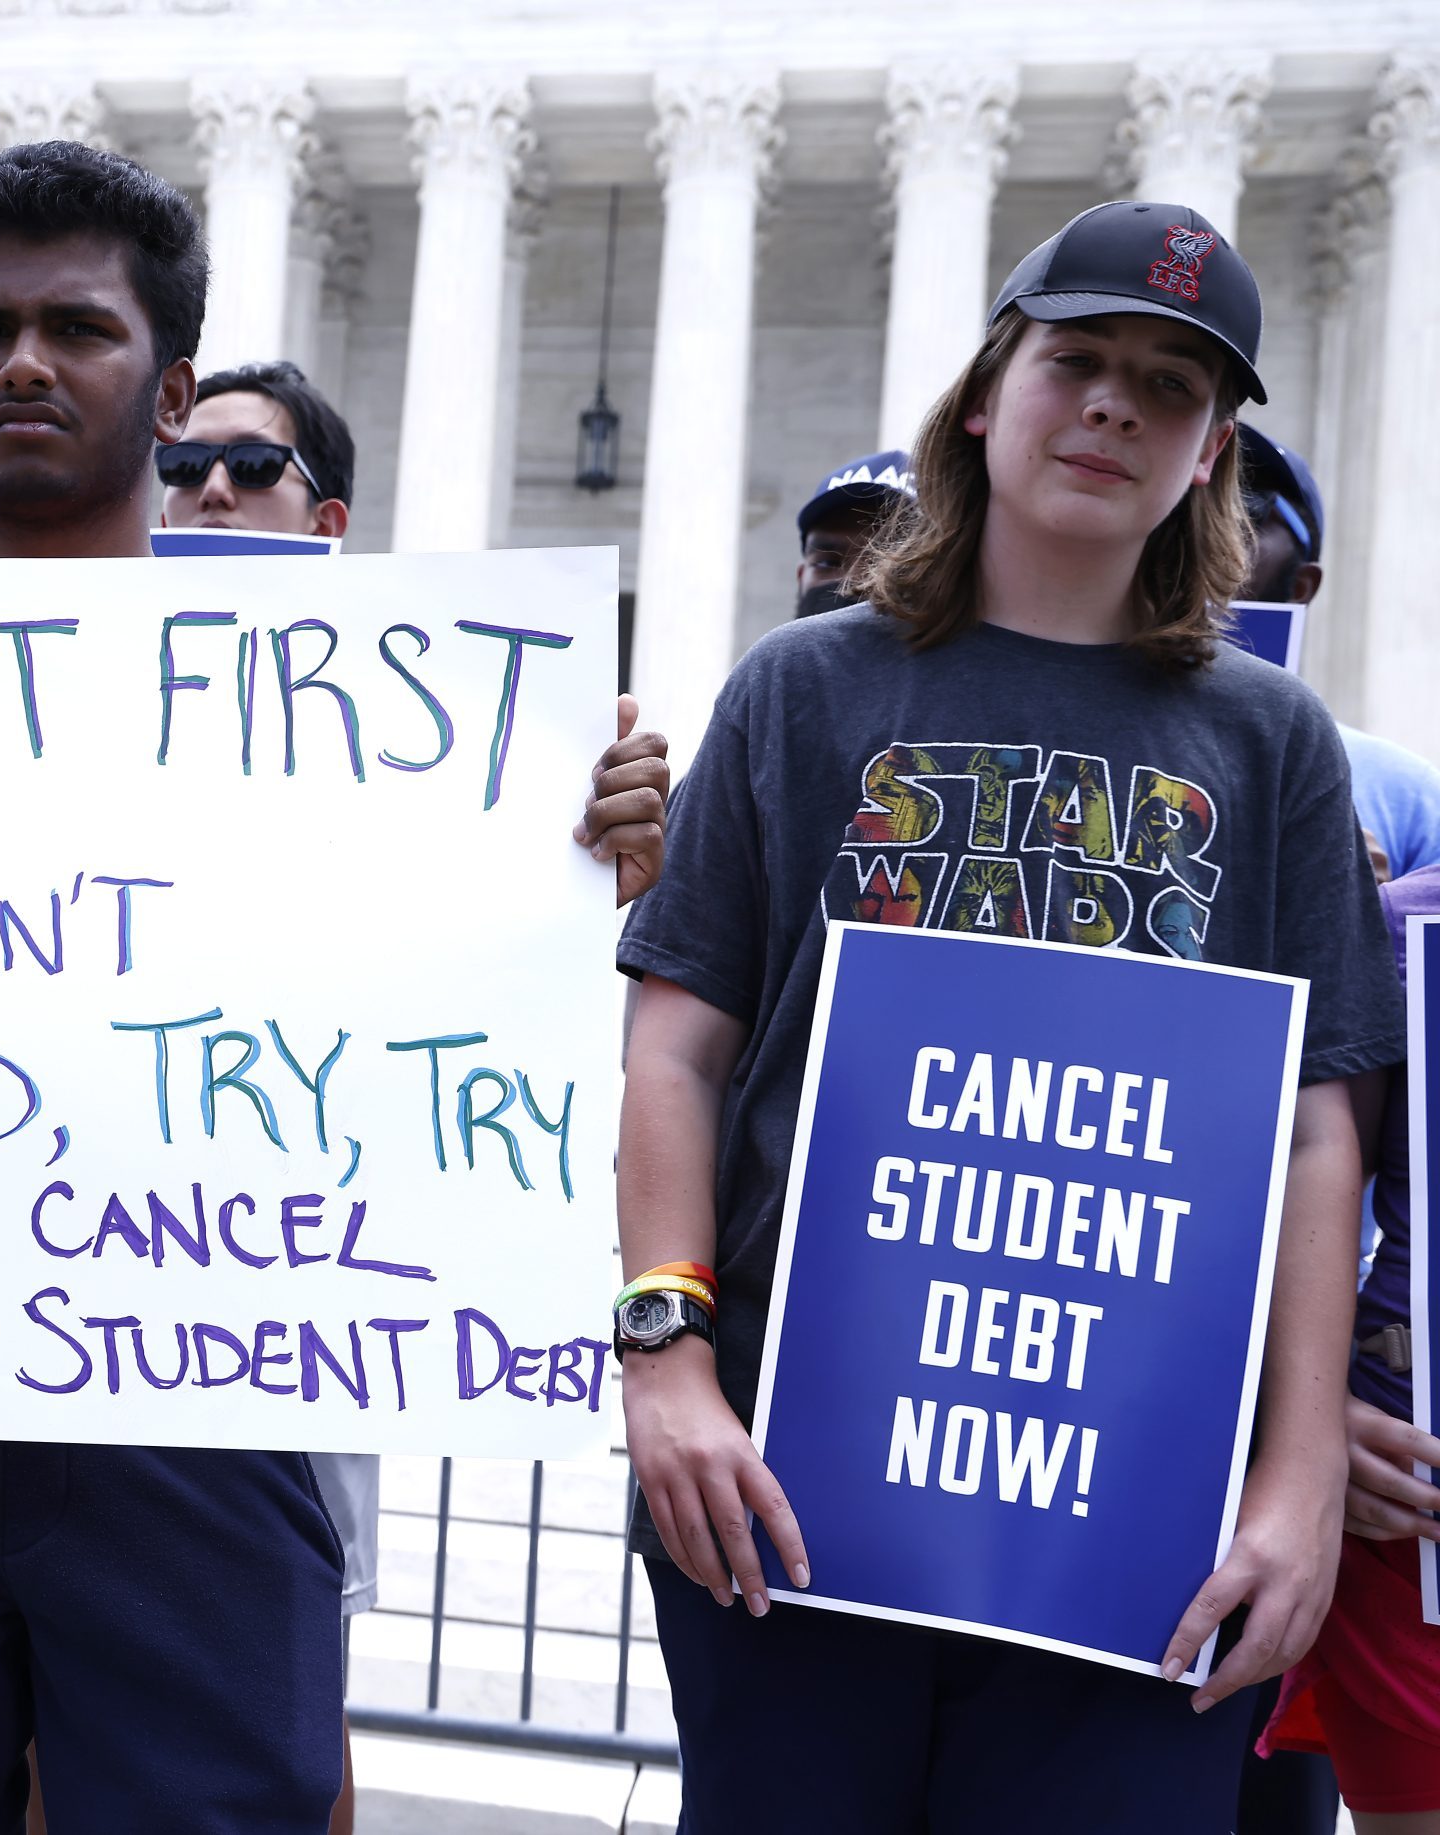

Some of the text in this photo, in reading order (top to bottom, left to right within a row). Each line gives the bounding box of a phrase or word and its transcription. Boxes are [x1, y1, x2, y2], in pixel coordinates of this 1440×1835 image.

[827, 464, 917, 497] NAAC
[157, 612, 574, 811] FIRST
[841, 742, 1222, 902] STAR
[110, 1007, 362, 1188] TRY,
[386, 1032, 575, 1203] TRY
[906, 1046, 1174, 1163] CANCEL
[31, 1180, 437, 1282] CANCEL
[866, 1156, 1191, 1283] STUDENT
[15, 1286, 612, 1412] STUDENT DEBT
[918, 1279, 1104, 1391] DEBT
[885, 1396, 1100, 1518] NOW!
